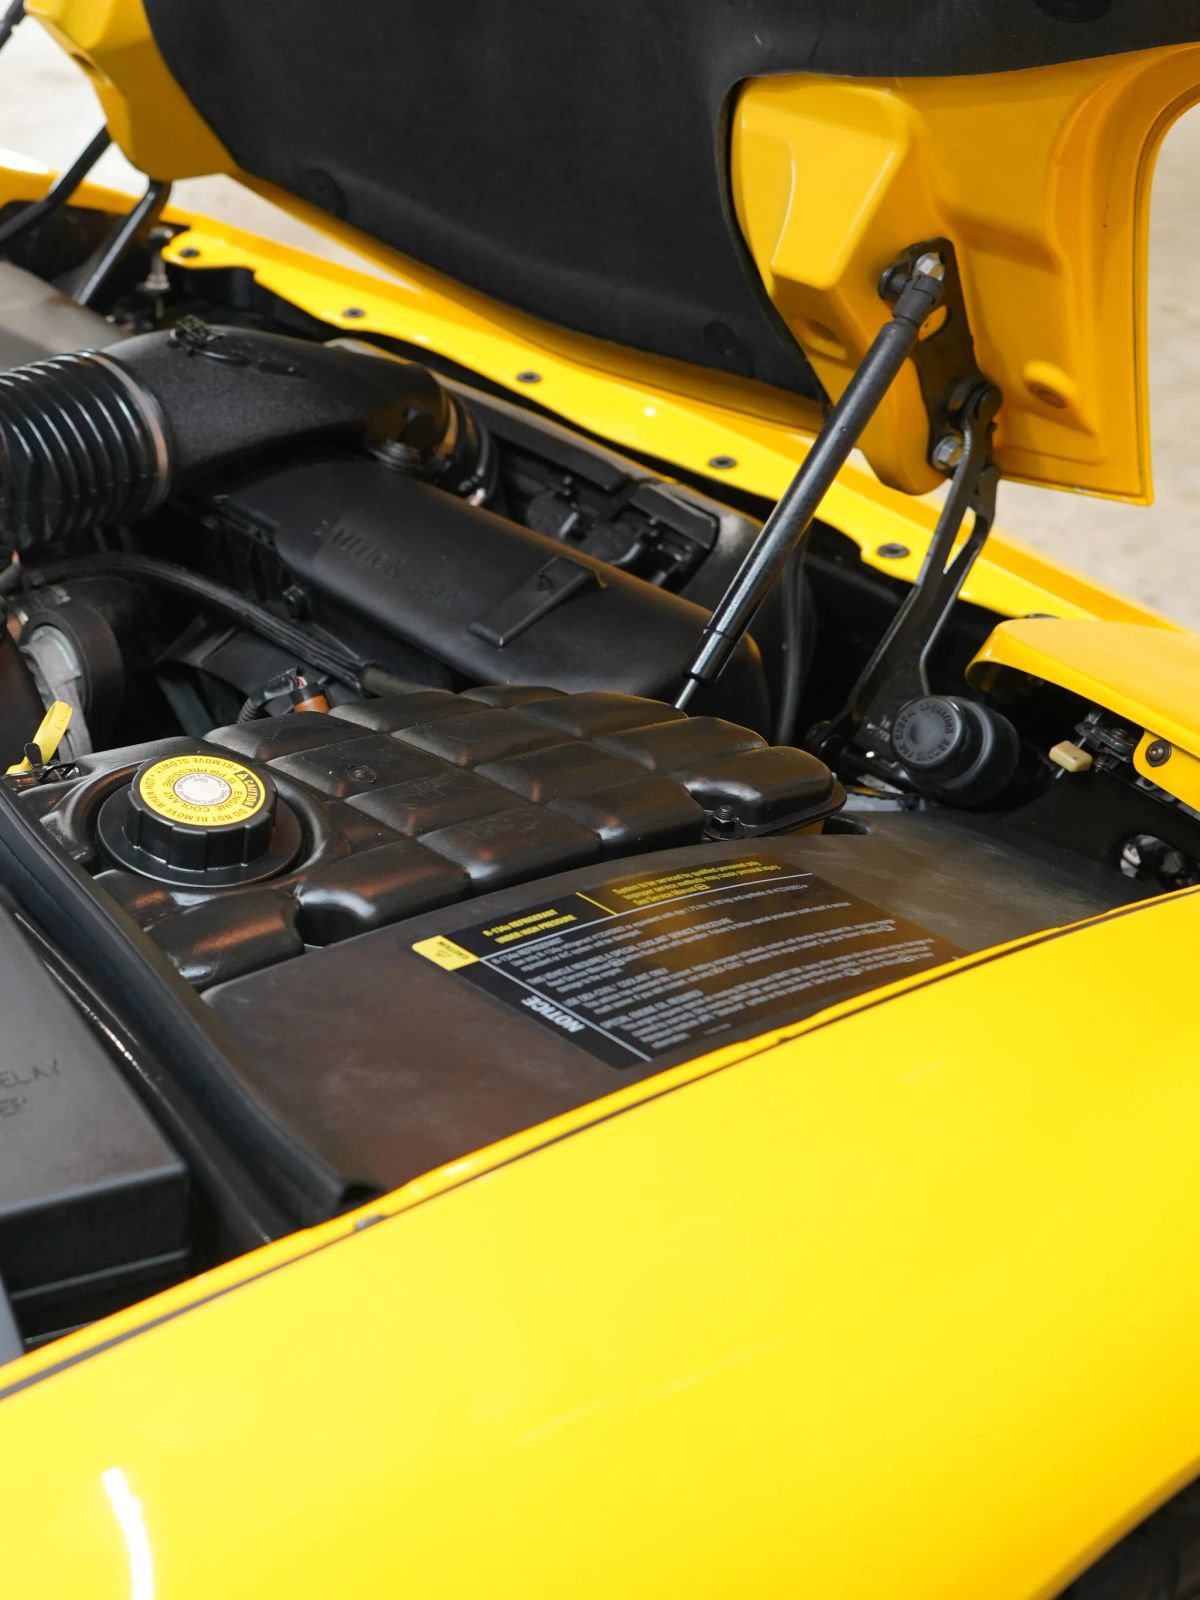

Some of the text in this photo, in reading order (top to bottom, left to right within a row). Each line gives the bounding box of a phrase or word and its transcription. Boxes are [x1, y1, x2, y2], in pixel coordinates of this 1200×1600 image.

[156, 757, 234, 774] REMOVE SLOWLY
[162, 767, 208, 788] PRESSURE
[144, 776, 248, 823] DO NOT REMOVE WHEN HOT
[163, 790, 243, 813] ENGINE COOLANT
[520, 994, 586, 1034] NOTICE
